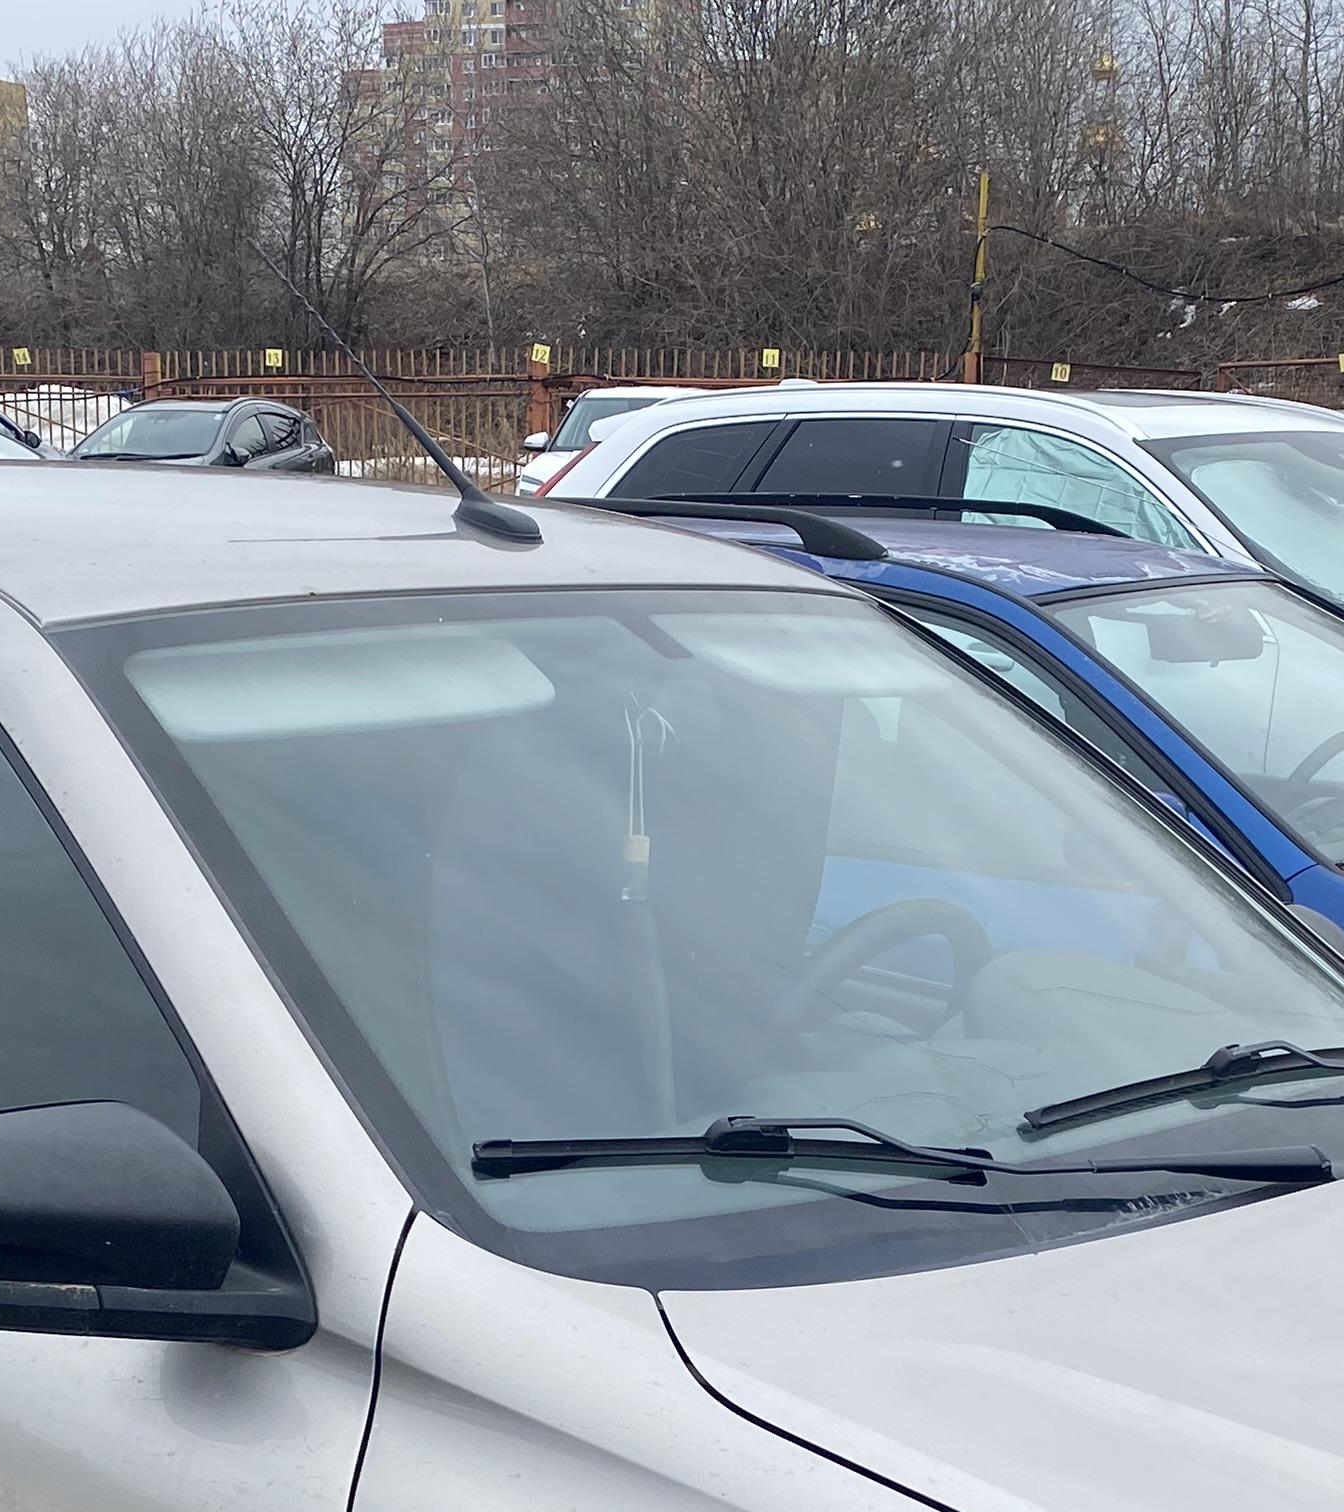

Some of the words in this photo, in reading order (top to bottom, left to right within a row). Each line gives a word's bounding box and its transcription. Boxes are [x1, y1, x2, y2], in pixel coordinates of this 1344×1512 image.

[16, 352, 27, 362] 14
[268, 352, 279, 363] 13
[534, 348, 547, 362] 12
[765, 354, 776, 365] 11
[1054, 367, 1066, 379] 10
